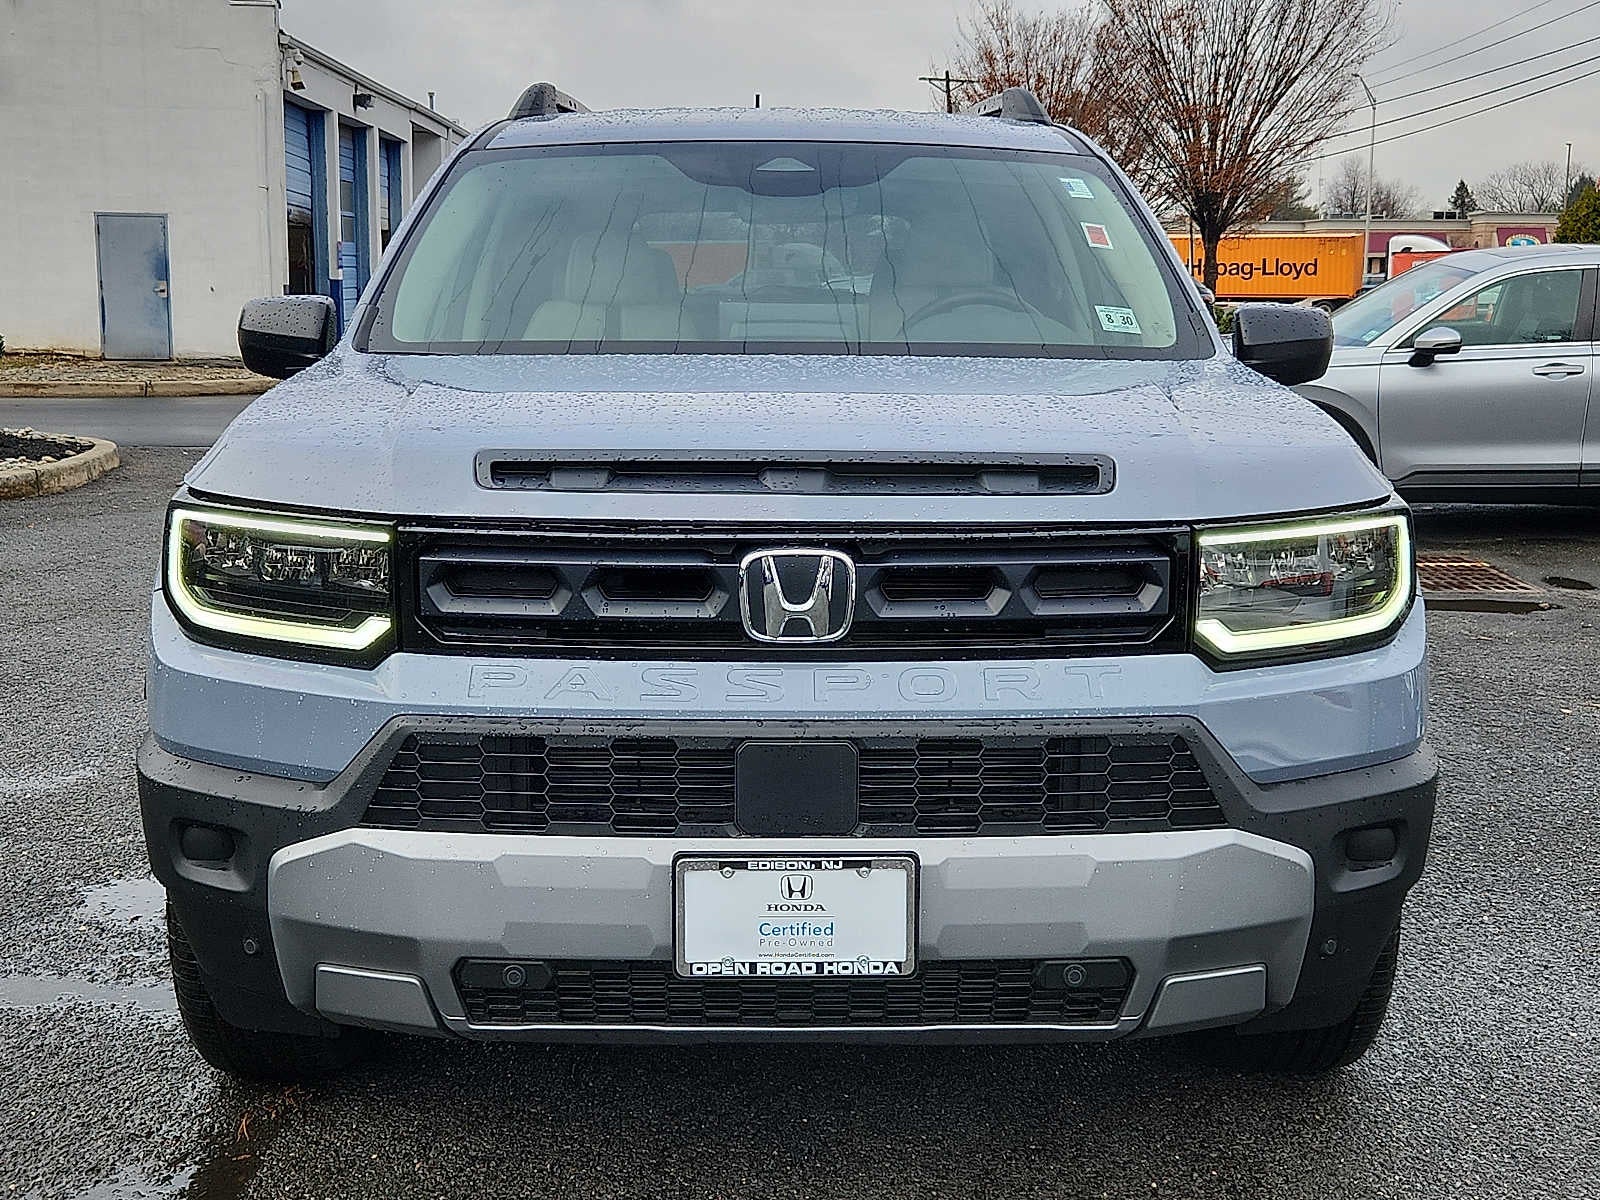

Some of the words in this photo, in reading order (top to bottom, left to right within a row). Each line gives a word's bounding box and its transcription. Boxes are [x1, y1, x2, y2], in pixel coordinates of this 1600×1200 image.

[1186, 258, 1318, 280] Hpag-Lloyd
[1105, 313, 1114, 324] 8
[1119, 315, 1134, 326] 30
[466, 664, 1123, 702] PASSPORT
[747, 860, 816, 871] EDISON,
[821, 860, 843, 870] NJ
[766, 903, 826, 912] HONDA
[759, 922, 834, 937] Certified
[759, 938, 833, 947] Pre-Owned
[692, 962, 749, 976] OPEN
[757, 962, 817, 975] ROAD
[823, 961, 900, 975] HONDA
